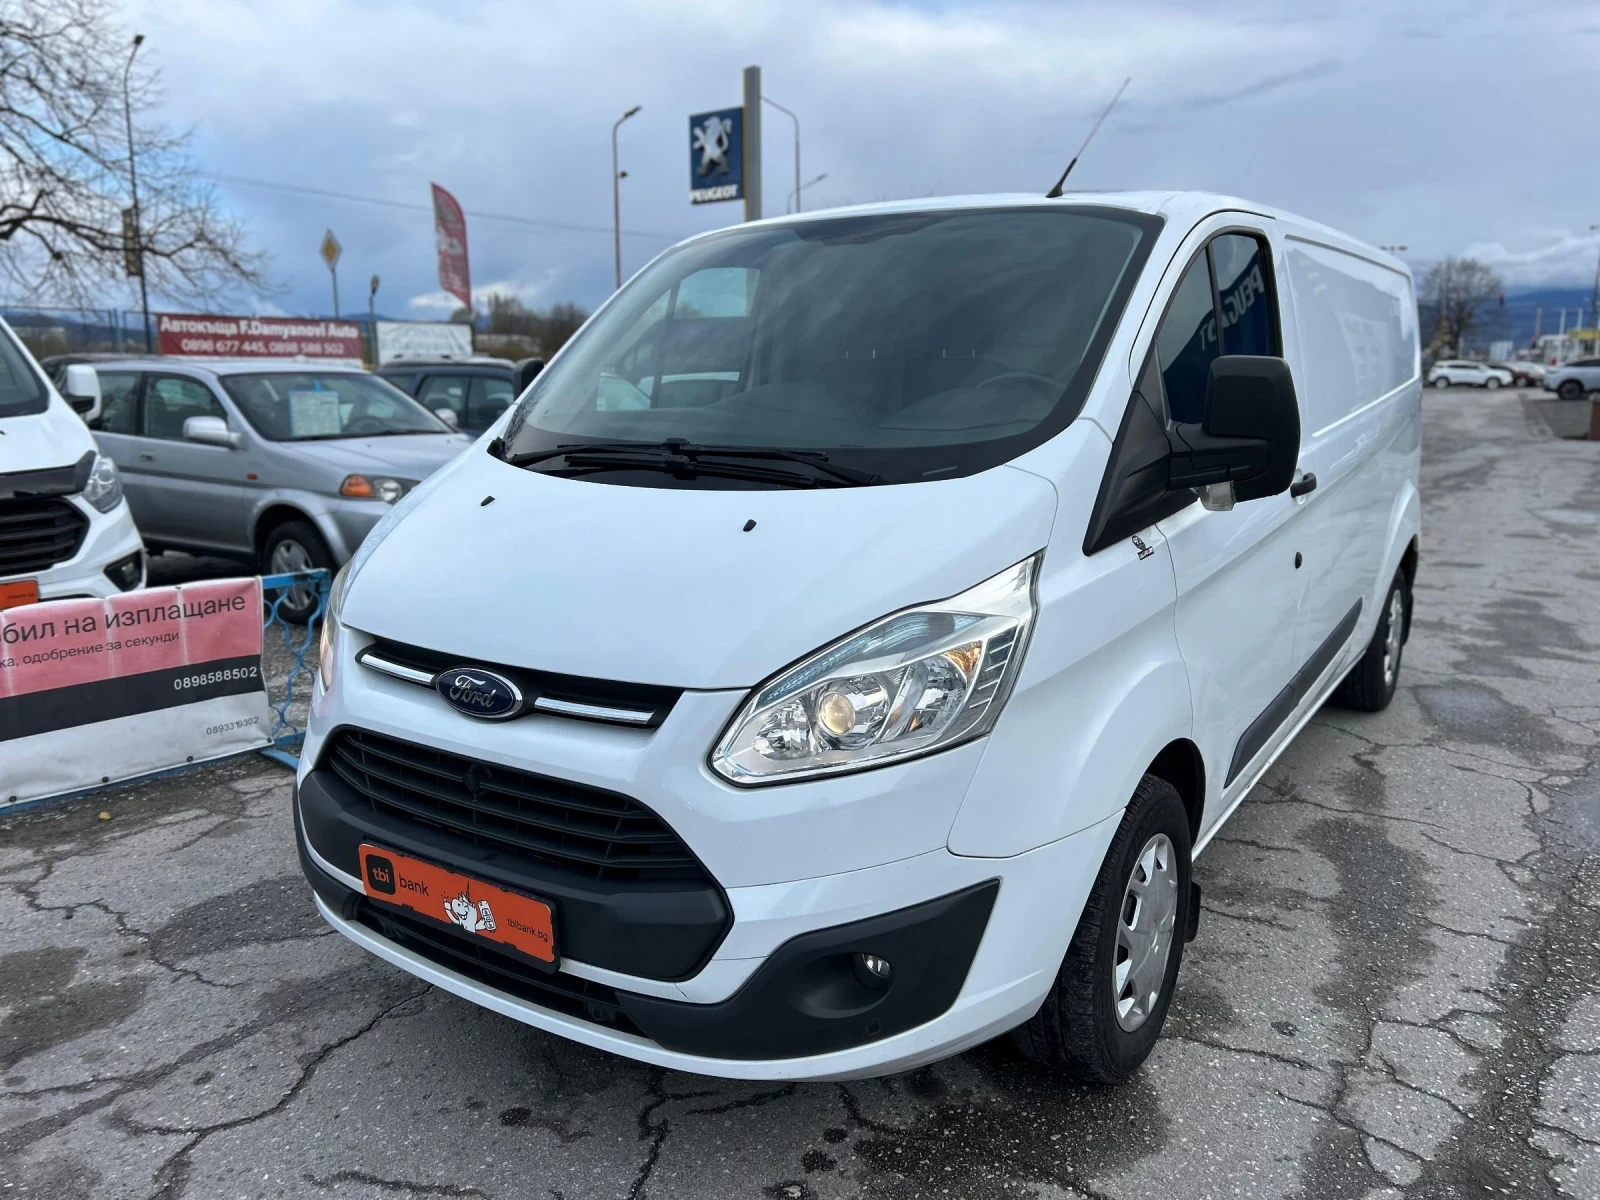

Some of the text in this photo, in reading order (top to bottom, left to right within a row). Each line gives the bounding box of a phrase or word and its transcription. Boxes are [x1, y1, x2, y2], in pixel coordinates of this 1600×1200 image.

[215, 339, 240, 353] 677
[0, 595, 246, 644] бил на изплащане
[22, 643, 104, 665] одобрение
[106, 640, 122, 651] за
[125, 632, 180, 648] секунди
[173, 666, 258, 690] 0898588502
[449, 674, 497, 708] Ford
[205, 716, 260, 735] 0893319302
[372, 867, 430, 896] tbi bank
[506, 917, 549, 943] tbibank.bg
